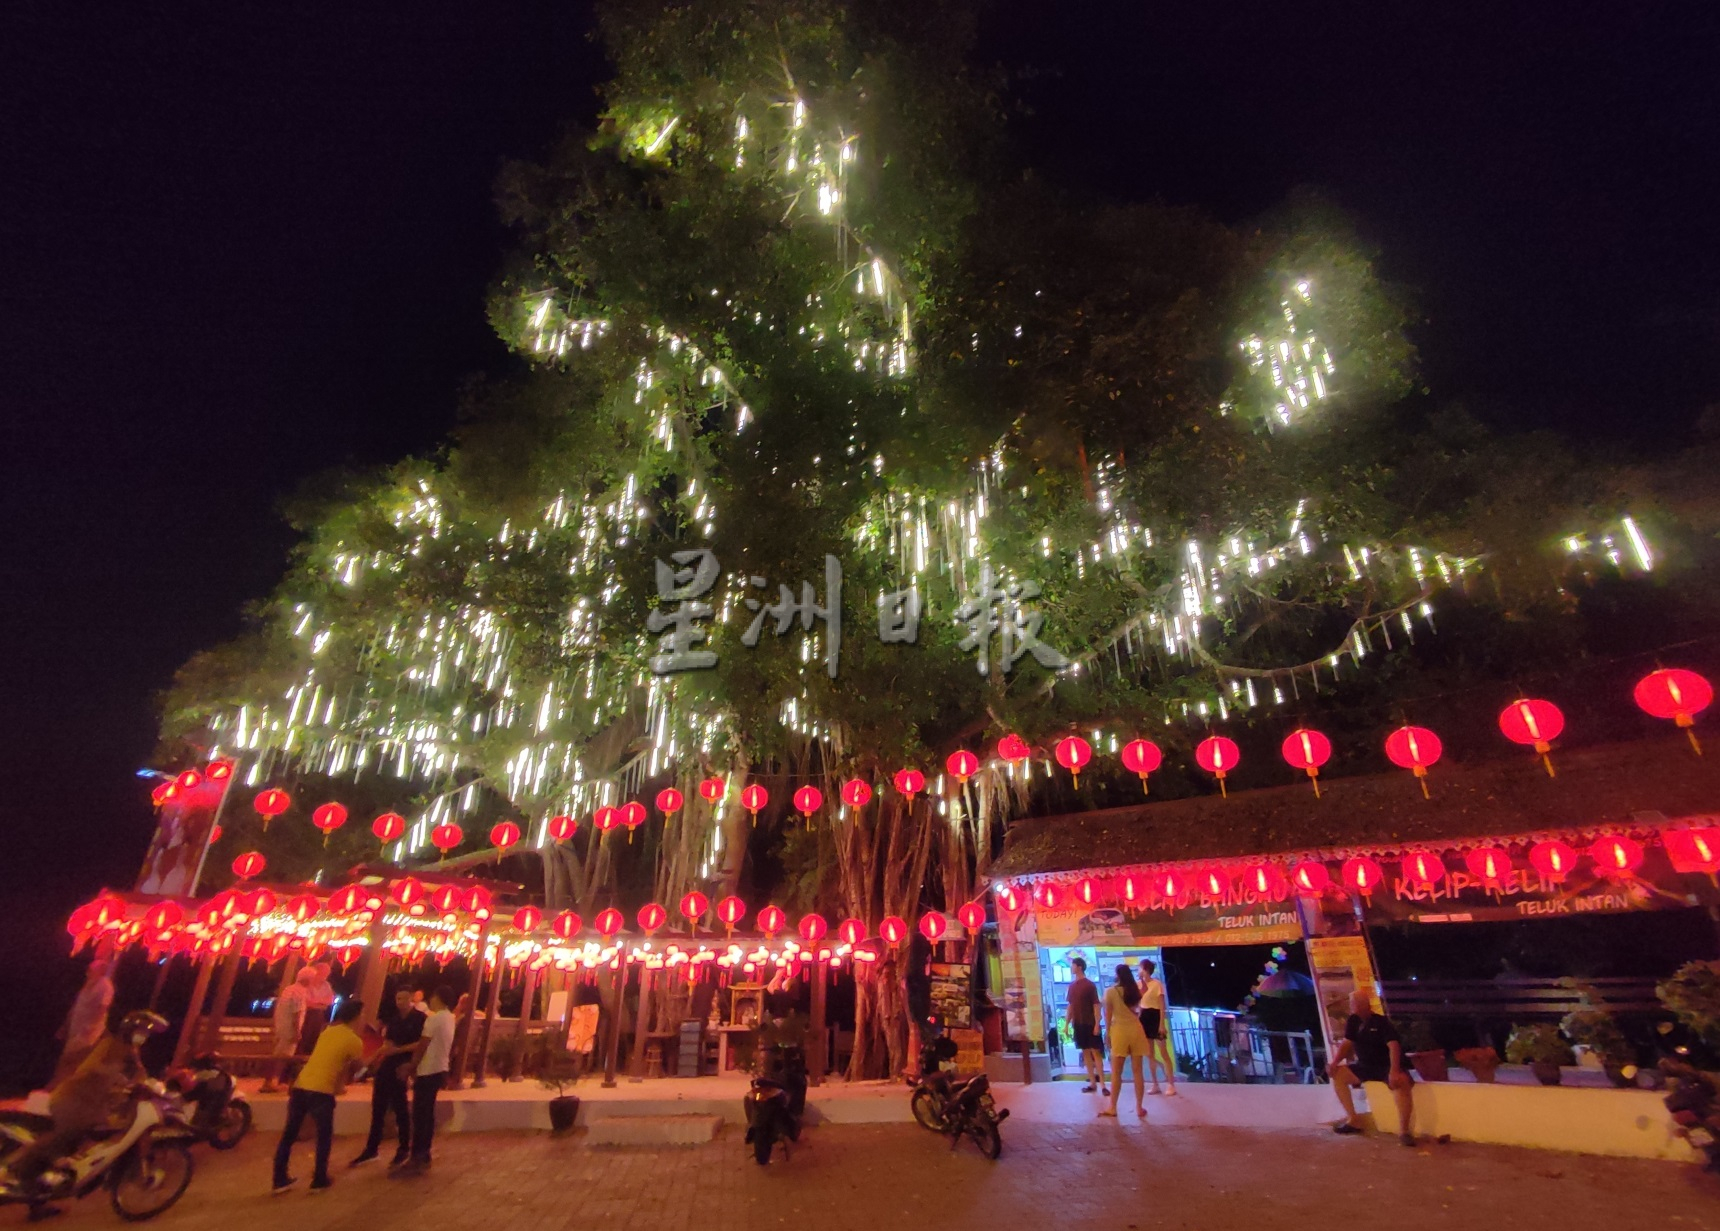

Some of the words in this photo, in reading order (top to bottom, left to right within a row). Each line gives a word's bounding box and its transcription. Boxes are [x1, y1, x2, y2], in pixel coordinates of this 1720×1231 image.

[1516, 898, 1569, 915] TELUK
[1575, 893, 1629, 912] INTAN
[1217, 915, 1254, 929] TELUK
[1258, 911, 1297, 926] INTAN
